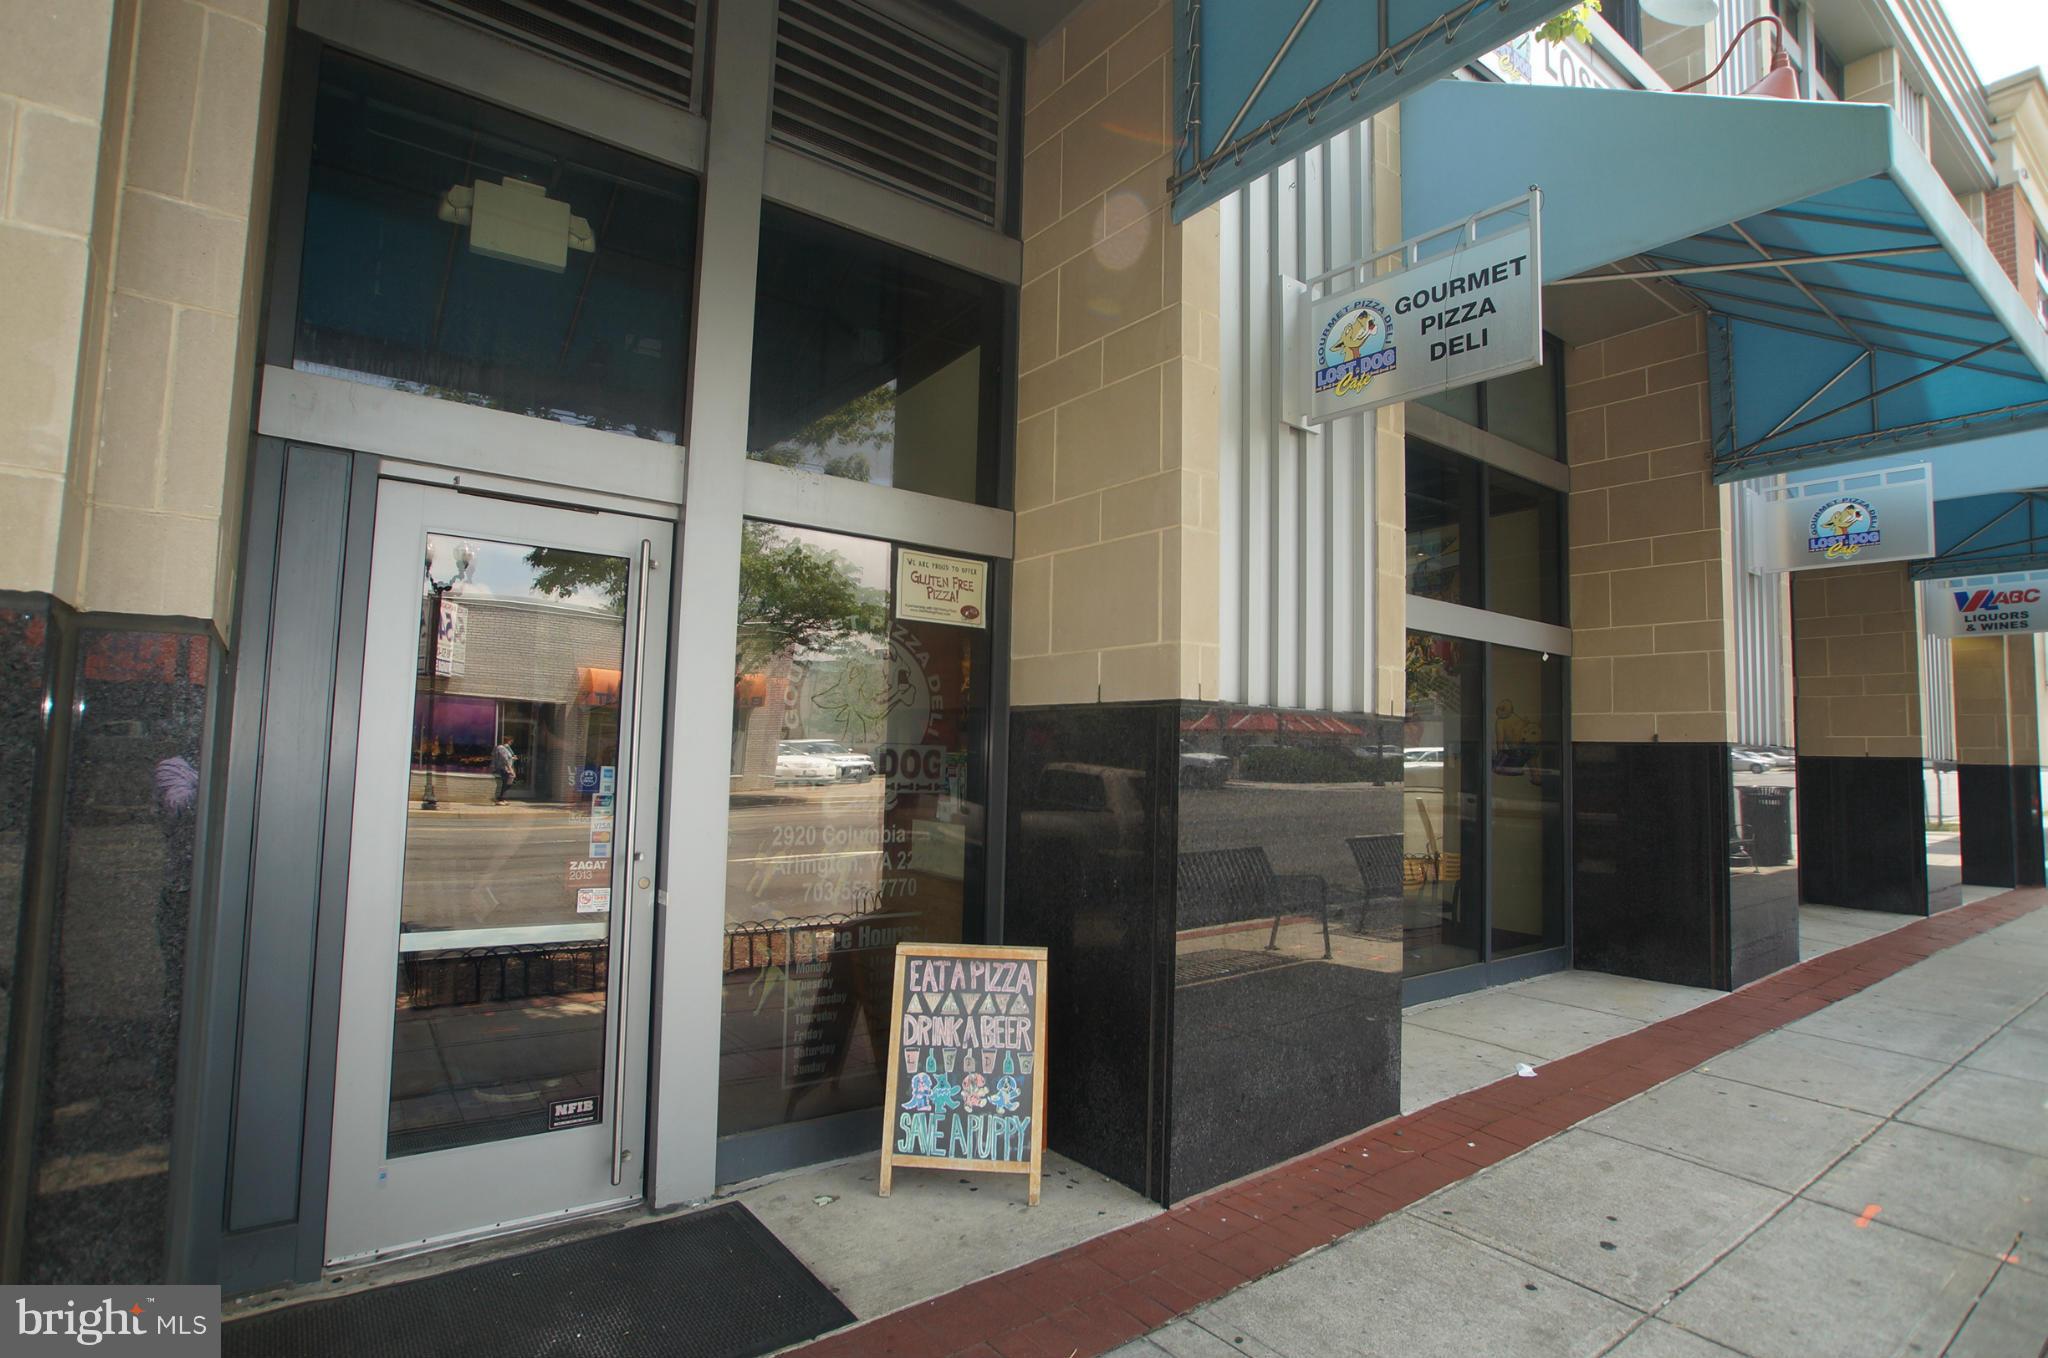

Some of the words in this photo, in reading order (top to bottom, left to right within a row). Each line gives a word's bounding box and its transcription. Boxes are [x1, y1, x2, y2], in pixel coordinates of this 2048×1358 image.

[1394, 254, 1528, 315] GOURMET
[1421, 297, 1497, 335] PIZZA
[1318, 305, 1350, 365] GOURMET
[1354, 300, 1385, 314] PIZZA
[1384, 314, 1394, 344] DELI
[1430, 328, 1488, 362] DELI
[1317, 360, 1357, 387] LOST
[1360, 348, 1396, 373] DOG
[1841, 498, 1870, 509] PIZZA
[1810, 535, 1846, 549] LOST
[1848, 532, 1880, 544] DOG
[918, 560, 930, 569] ARE
[931, 563, 949, 571] PROUD
[910, 571, 949, 588] GLUTEN
[952, 576, 975, 592] FREE
[926, 586, 960, 603] PIZZA!
[1991, 588, 2041, 605] ABC
[1964, 610, 2030, 623] LIQUORS
[1965, 624, 1976, 632] &
[1980, 620, 2030, 632] WINES
[927, 675, 944, 738] DELI
[879, 749, 942, 780] DOG
[772, 825, 817, 847] 2920
[822, 823, 906, 846] Columbia
[568, 870, 593, 881] 2013
[569, 860, 608, 871] ZAGAT
[909, 960, 951, 993] EAT
[951, 959, 967, 991] A
[970, 961, 1034, 996] PIZZA
[903, 1013, 963, 1047] DRINK
[962, 1015, 980, 1050] A
[980, 1015, 1033, 1052] BEER
[554, 1100, 594, 1117] NFIB
[897, 1112, 947, 1157] SAVE
[949, 1114, 968, 1160] A
[966, 1114, 1031, 1162] PUPPY
